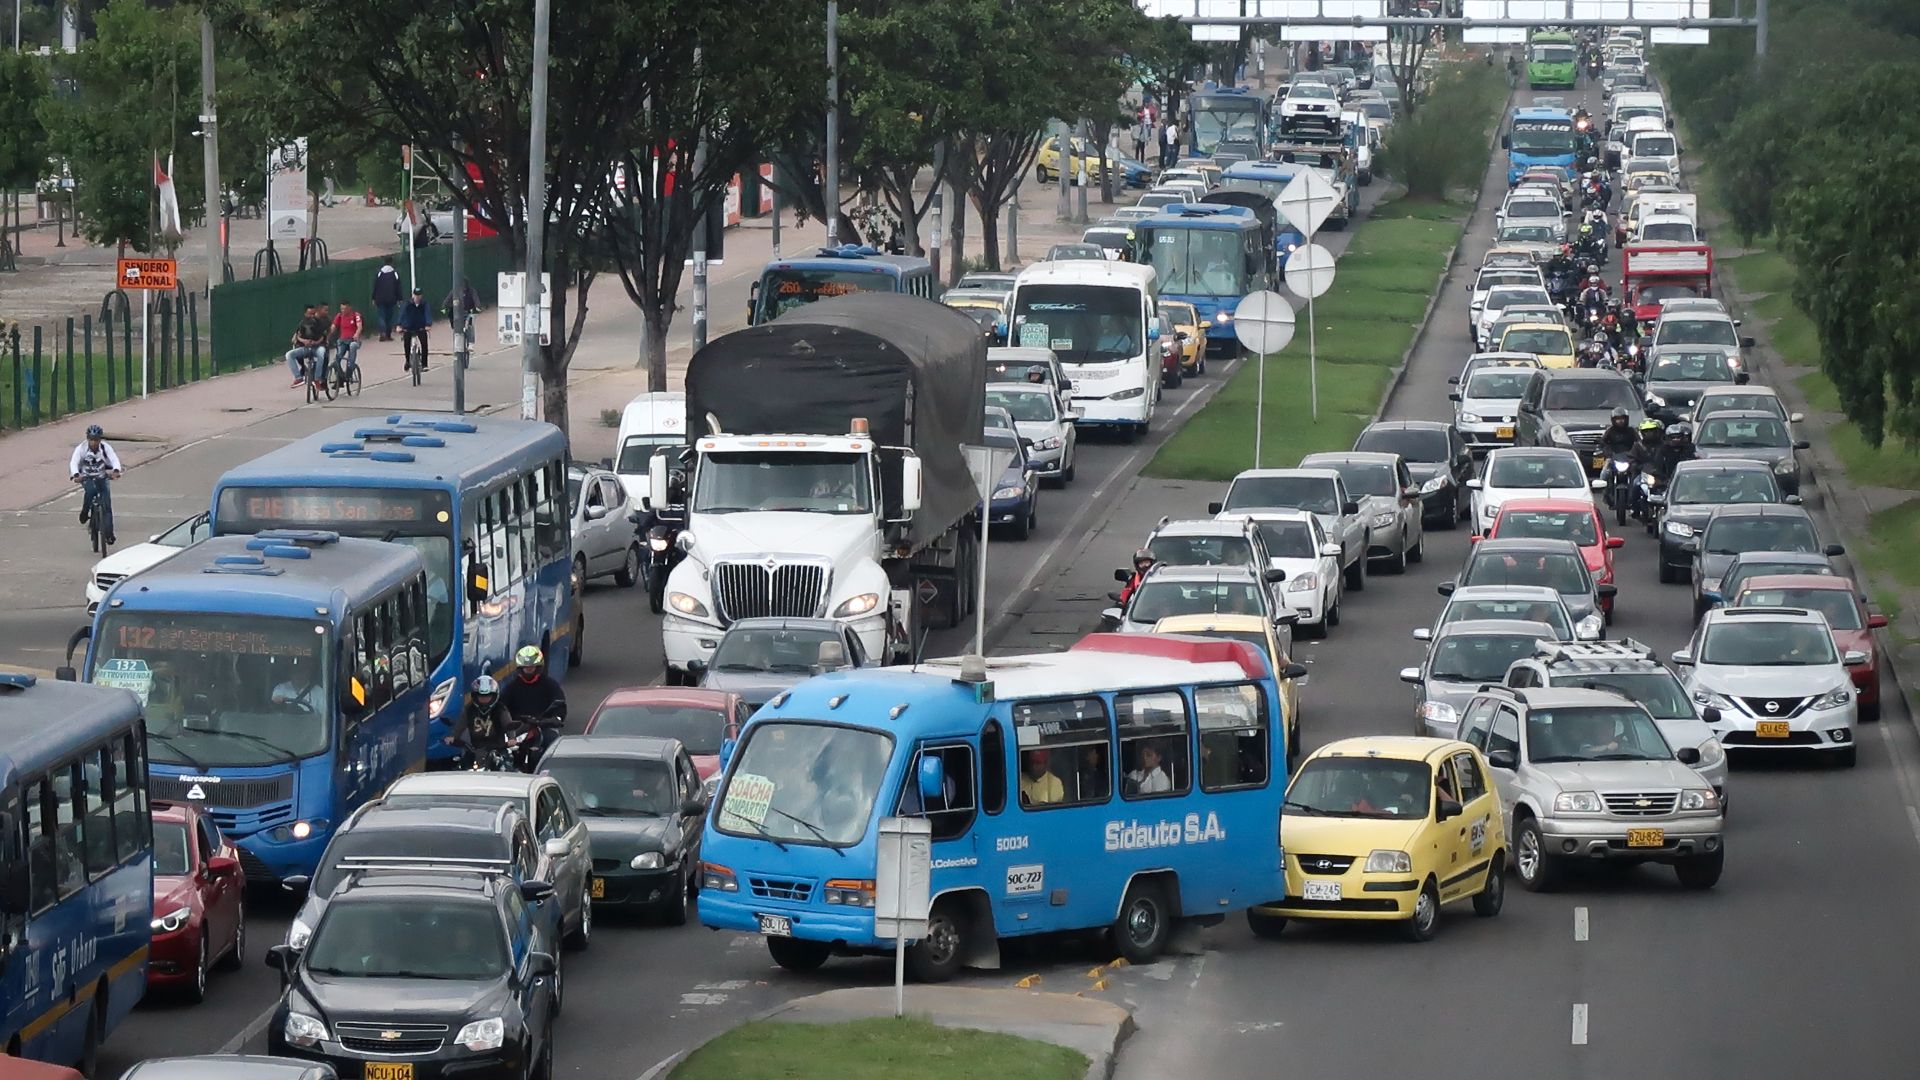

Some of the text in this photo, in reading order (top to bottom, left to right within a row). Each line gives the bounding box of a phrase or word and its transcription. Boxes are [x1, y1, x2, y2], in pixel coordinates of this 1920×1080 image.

[125, 261, 170, 273] SENDERO
[121, 275, 172, 286] PEATONAL
[118, 626, 156, 648] 132
[116, 660, 137, 671] 132
[179, 774, 221, 783] Marcopolo
[728, 779, 771, 802] SOACHA
[724, 797, 768, 818] COMPARTIR
[1105, 811, 1226, 851] Sidauto S.A.
